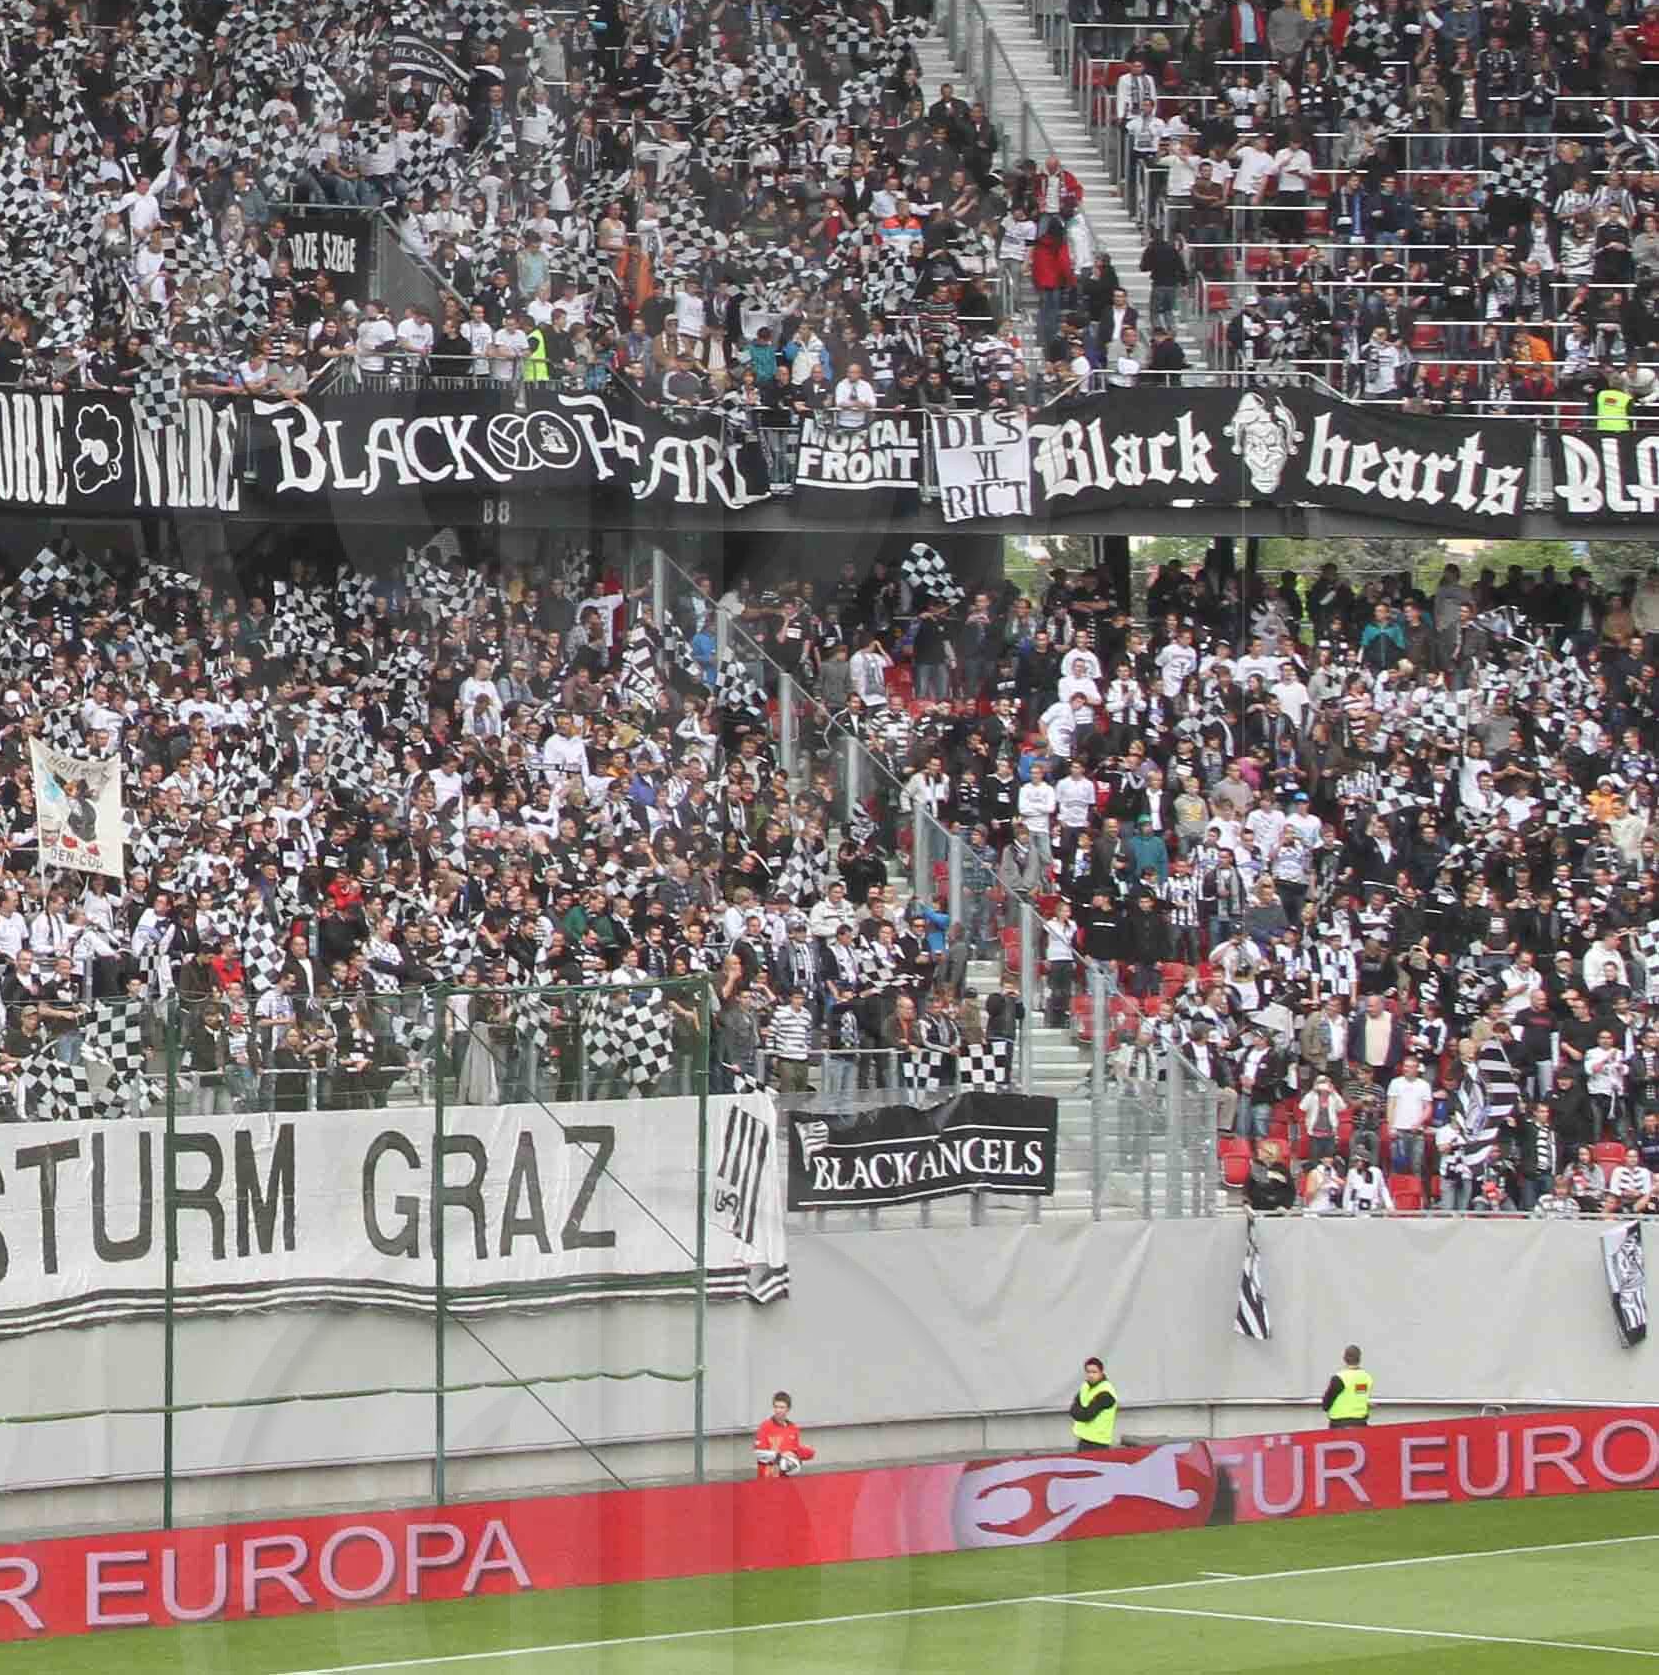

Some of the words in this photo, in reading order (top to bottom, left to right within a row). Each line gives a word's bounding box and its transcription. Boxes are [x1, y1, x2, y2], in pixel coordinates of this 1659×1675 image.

[254, 399, 512, 495] BLACK
[559, 394, 771, 509] PEARL
[796, 446, 919, 482] FRONT
[1027, 409, 1219, 500] Black
[1306, 412, 1524, 516] hearts
[482, 499, 511, 525] B8
[361, 1121, 617, 1263] GRAZ
[813, 1149, 917, 1191] BLACK
[85, 1519, 532, 1626] EUROPA
